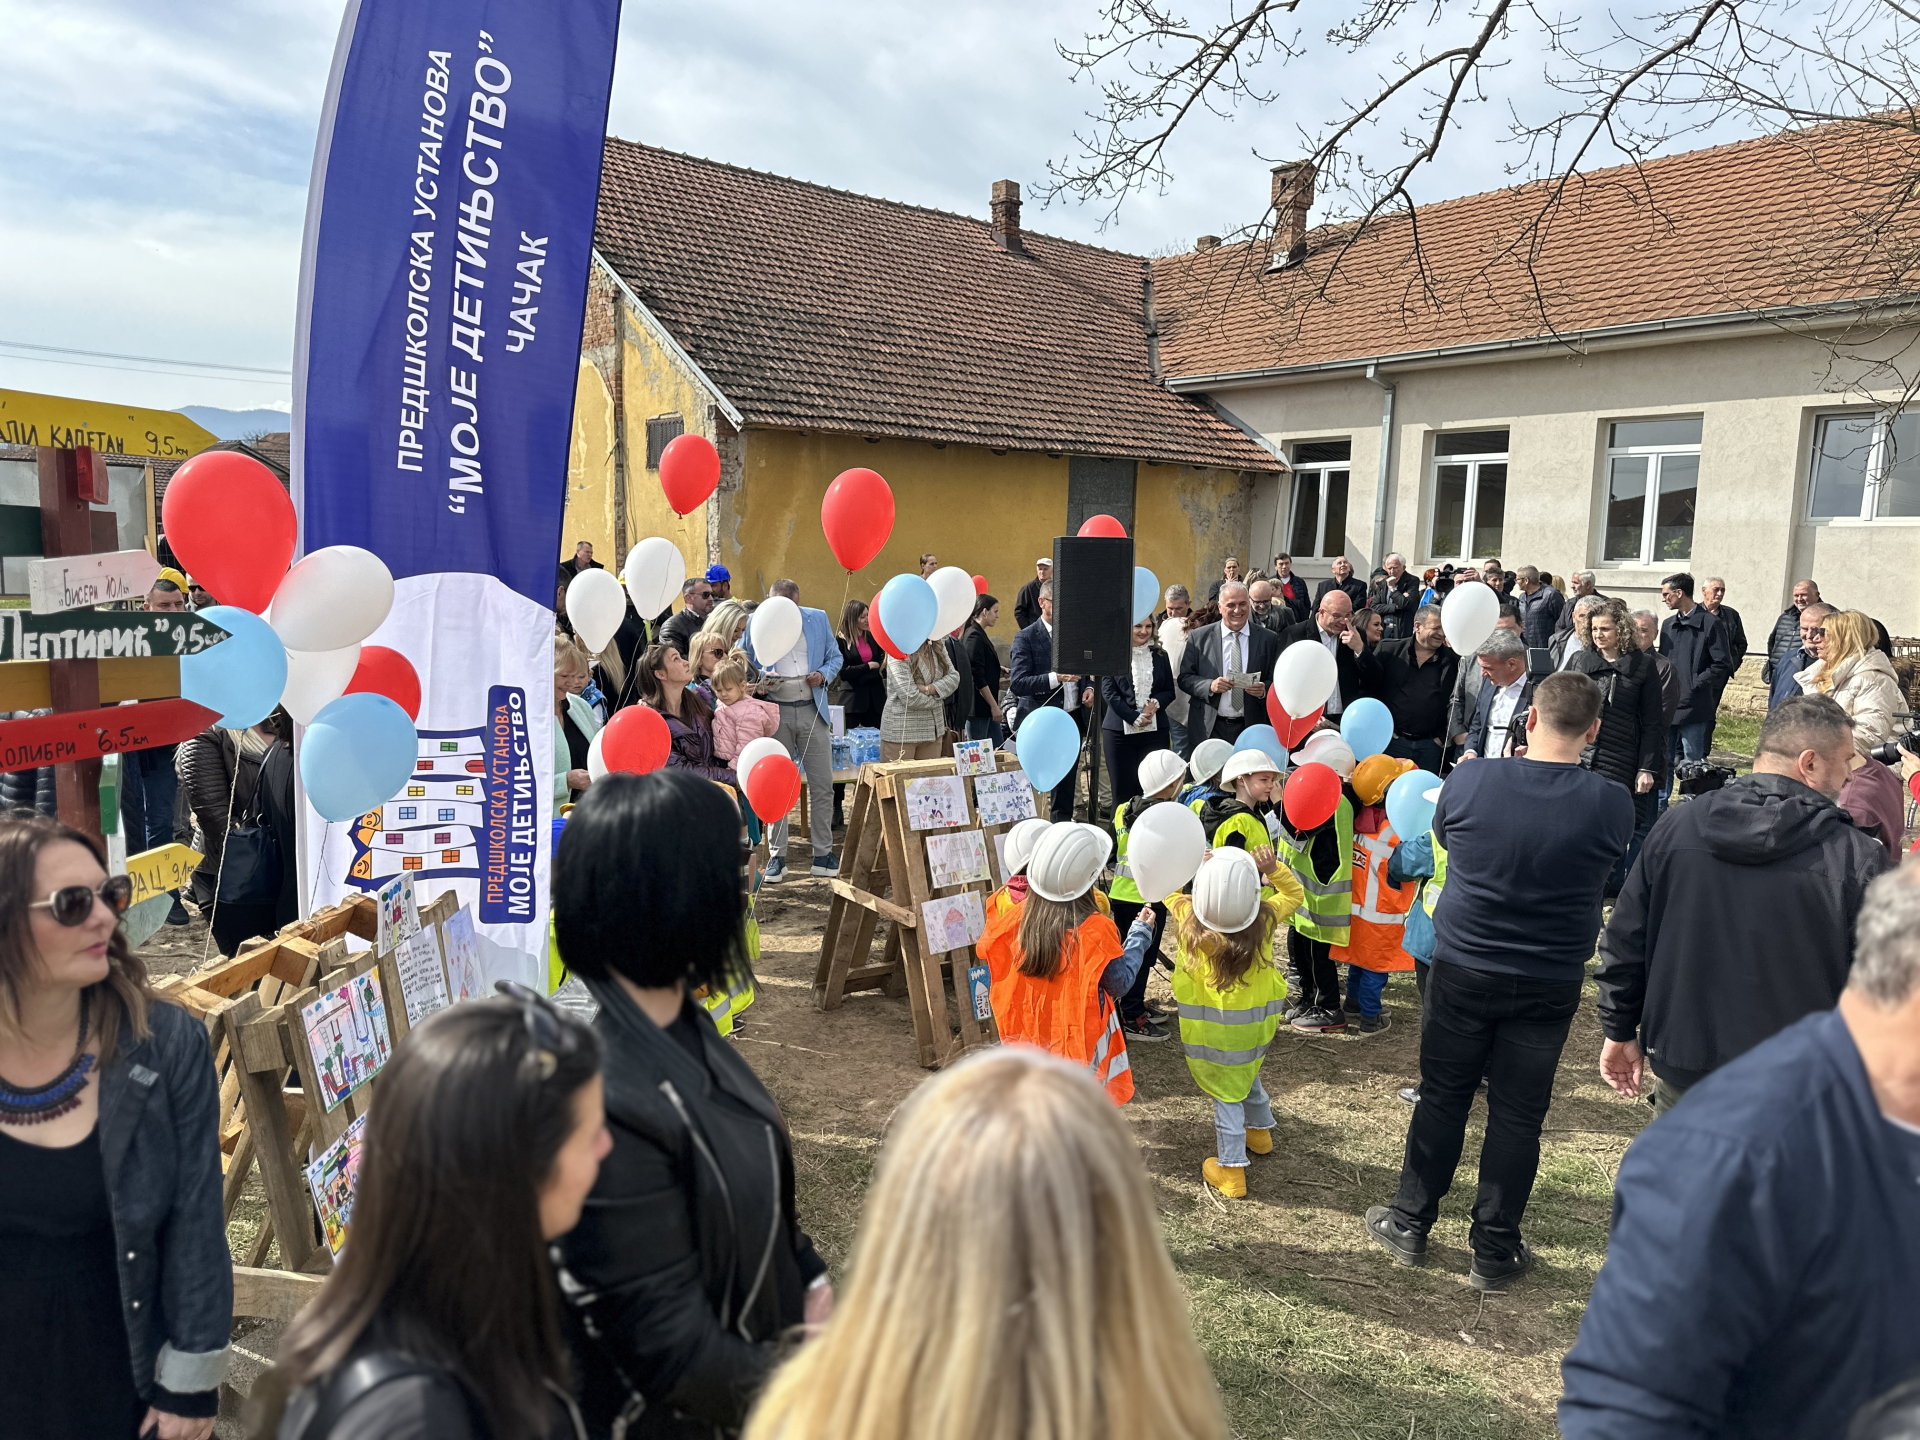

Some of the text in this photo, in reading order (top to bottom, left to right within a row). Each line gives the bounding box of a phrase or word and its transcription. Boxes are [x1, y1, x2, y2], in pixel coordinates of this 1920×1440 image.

[397, 49, 452, 472] ПРЕДШКОЛСКА УСТАНОВА
[448, 30, 513, 515] “МОЈЕ ДЕТИЊСТВО”
[505, 231, 549, 354] ЧАЧАК
[487, 704, 511, 904] ПРЕДШКОЛСКА УСТАНОВА
[508, 692, 535, 916] МОЈЕ ДЕТИЊСТВО
